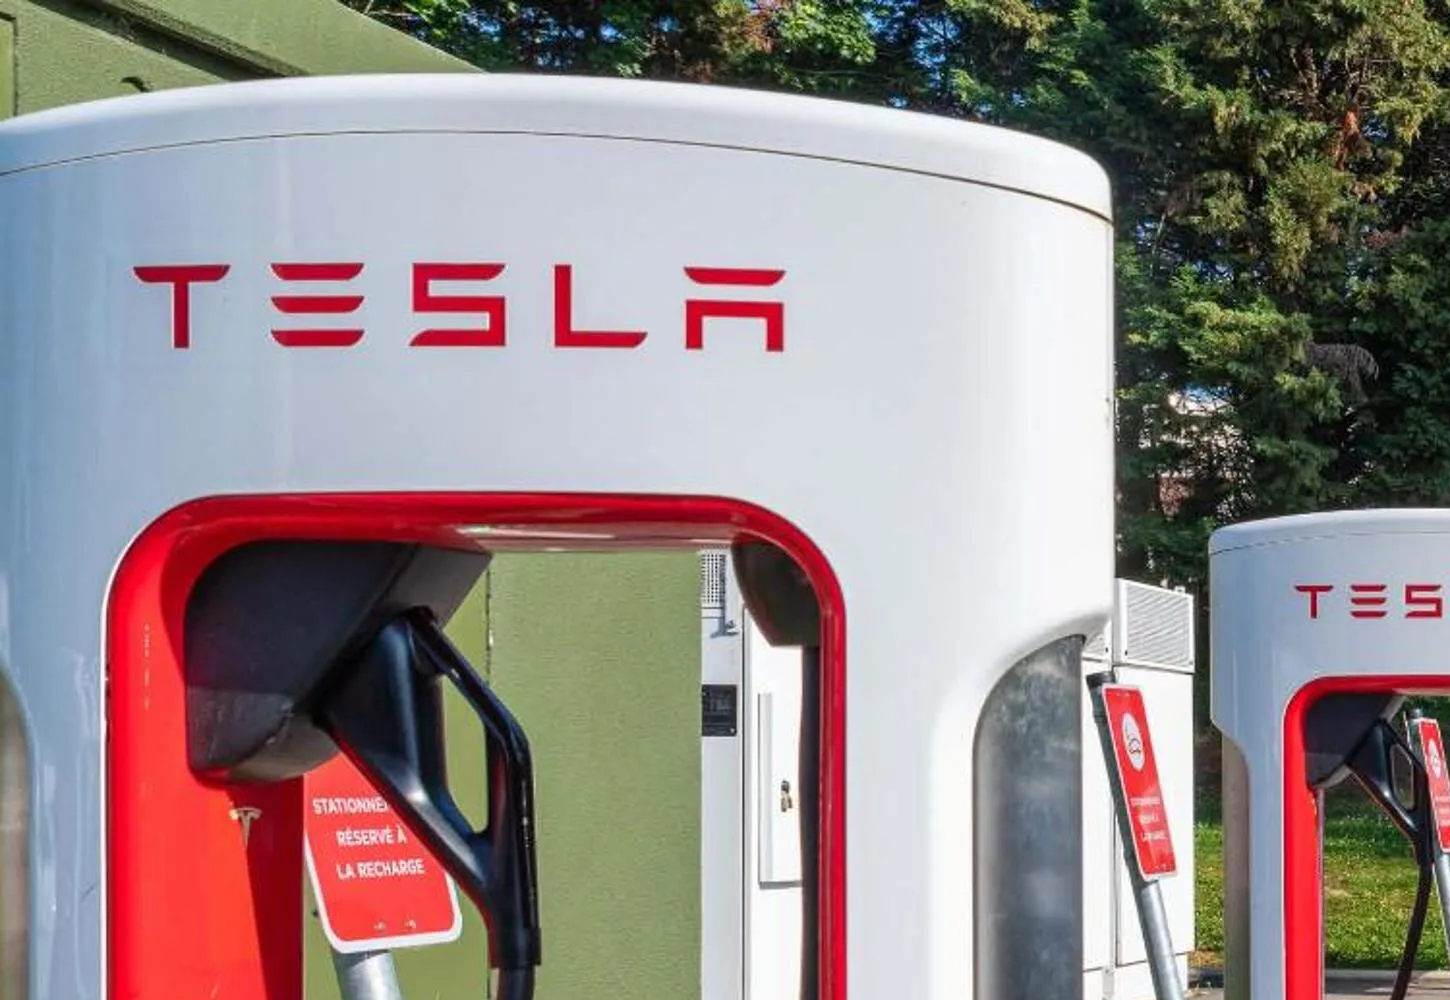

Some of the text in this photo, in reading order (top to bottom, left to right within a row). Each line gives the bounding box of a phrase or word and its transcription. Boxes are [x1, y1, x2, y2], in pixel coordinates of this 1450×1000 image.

[133, 262, 786, 352] TESLA
[312, 796, 389, 815] STATIONNE
[336, 859, 425, 880] LA RECHARGE
